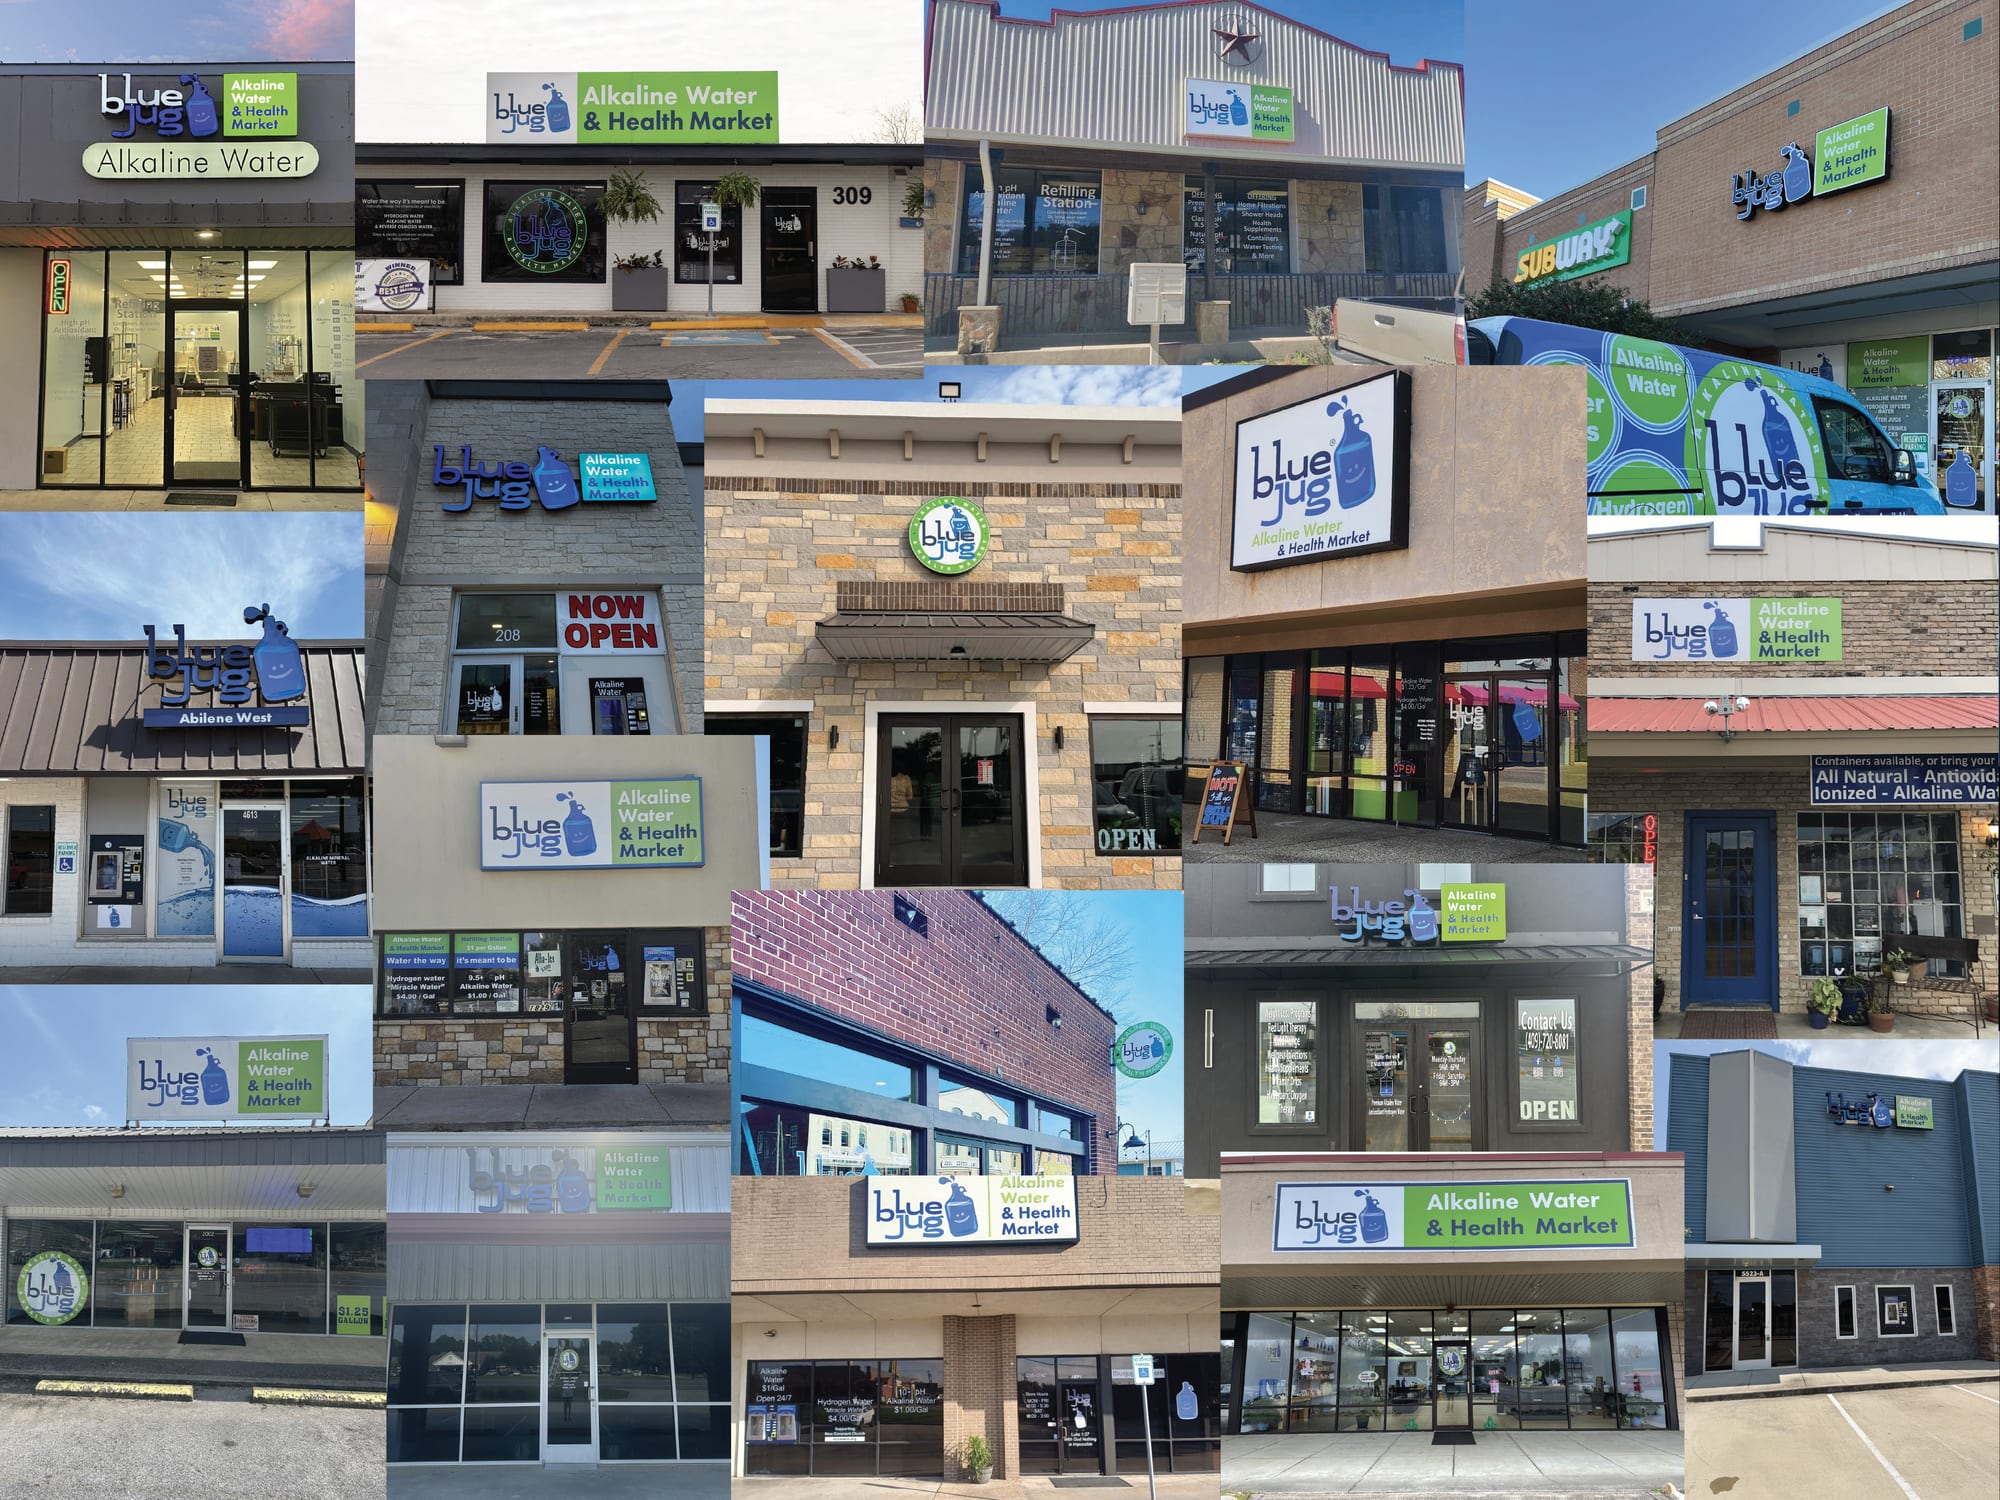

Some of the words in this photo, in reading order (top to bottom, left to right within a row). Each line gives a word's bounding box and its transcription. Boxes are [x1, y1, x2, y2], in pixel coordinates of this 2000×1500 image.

[231, 80, 285, 91] Alkaline
[231, 93, 272, 104] Water
[583, 85, 677, 104] Alkaline
[686, 86, 757, 104] Water
[1253, 94, 1289, 105] Alkaline
[232, 106, 241, 116] &
[246, 106, 288, 117] Health
[1254, 103, 1281, 113] Water
[232, 119, 278, 130] Market
[584, 112, 601, 131] &
[608, 111, 683, 131] Health
[690, 112, 773, 131] Market
[1254, 114, 1262, 122] &
[1262, 114, 1291, 124] Health
[1254, 123, 1285, 133] Market
[1824, 121, 1875, 147] Alkaline
[1824, 141, 1861, 159] Water
[97, 149, 209, 173] Alkaline
[220, 148, 304, 173] Water
[1824, 160, 1833, 172] &
[1836, 147, 1877, 168] Health
[1823, 165, 1867, 186] Market
[832, 187, 872, 205] 309
[1040, 185, 1096, 199] Refilling
[1043, 198, 1092, 209] Station
[1514, 220, 1625, 282] SUBWAY
[53, 264, 66, 311] OPEN
[1616, 348, 1685, 376] Alkaline
[1627, 374, 1676, 398] Water
[586, 455, 641, 465] Alkaline
[586, 466, 629, 476] Water
[588, 478, 596, 487] &
[602, 477, 649, 488] Health
[589, 489, 640, 500] Market
[1597, 500, 1687, 515] Hydrogen
[1252, 528, 1300, 548] Alkaline
[1302, 520, 1343, 539] Water
[1278, 545, 1287, 556] &
[1289, 538, 1325, 555] Health
[1328, 530, 1371, 550] Market
[569, 596, 645, 619] NOW
[1759, 602, 1829, 617] Alkaline
[1759, 617, 1812, 630] Water
[496, 630, 521, 642] 208
[565, 624, 658, 648] OPEN
[1758, 632, 1771, 644] &
[1774, 630, 1830, 644] Health
[1758, 644, 1821, 658] Market
[595, 681, 625, 689] Alkaline
[598, 688, 622, 696] Water
[180, 712, 233, 724] Abilene
[236, 712, 273, 724] West
[1394, 764, 1416, 775] OPEN
[1815, 756, 1871, 767] Containers
[1874, 756, 1926, 769] available,
[1928, 759, 1937, 767] or
[1940, 756, 1968, 770] bring
[1970, 759, 1996, 770] your
[1817, 770, 1839, 784] All
[1844, 770, 1908, 784] Natural
[618, 790, 691, 806] Alkaline
[1815, 786, 1876, 801] Ionized
[1894, 785, 1962, 800] Alkaline
[242, 810, 258, 820] 4613
[618, 808, 674, 823] Water
[620, 827, 632, 840] &
[638, 824, 698, 840] Health
[1099, 828, 1156, 850] OPEN
[620, 843, 684, 858] Market
[1448, 891, 1496, 900] Alkaline
[1448, 902, 1482, 912] Water
[1448, 914, 1457, 923] &
[1462, 914, 1499, 924] Health
[1448, 926, 1489, 935] Market
[1521, 1011, 1555, 1030] Contact
[1557, 1012, 1572, 1030] Us
[1526, 1034, 1569, 1052] (409)-720-8081
[248, 1048, 310, 1061] Alkaline
[248, 1064, 294, 1076] Water
[248, 1080, 259, 1091] &
[264, 1078, 312, 1091] Health
[248, 1094, 301, 1107] Market
[1520, 1101, 1575, 1119] OPEN
[604, 1153, 659, 1163] Alkaline
[604, 1166, 643, 1176] Water
[604, 1180, 613, 1189] &
[619, 1180, 662, 1190] Health
[1001, 1176, 1064, 1189] Alkaline
[606, 1193, 652, 1203] Market
[1001, 1192, 1048, 1204] Water
[1428, 1194, 1519, 1211] Alkaline
[1528, 1192, 1600, 1209] Water
[1002, 1206, 1014, 1219] &
[1019, 1206, 1071, 1219] Health
[1002, 1222, 1059, 1235] Market
[1426, 1220, 1443, 1236] &
[1451, 1218, 1524, 1236] Health
[1536, 1216, 1618, 1234] Market
[338, 1306, 369, 1317] $1.25
